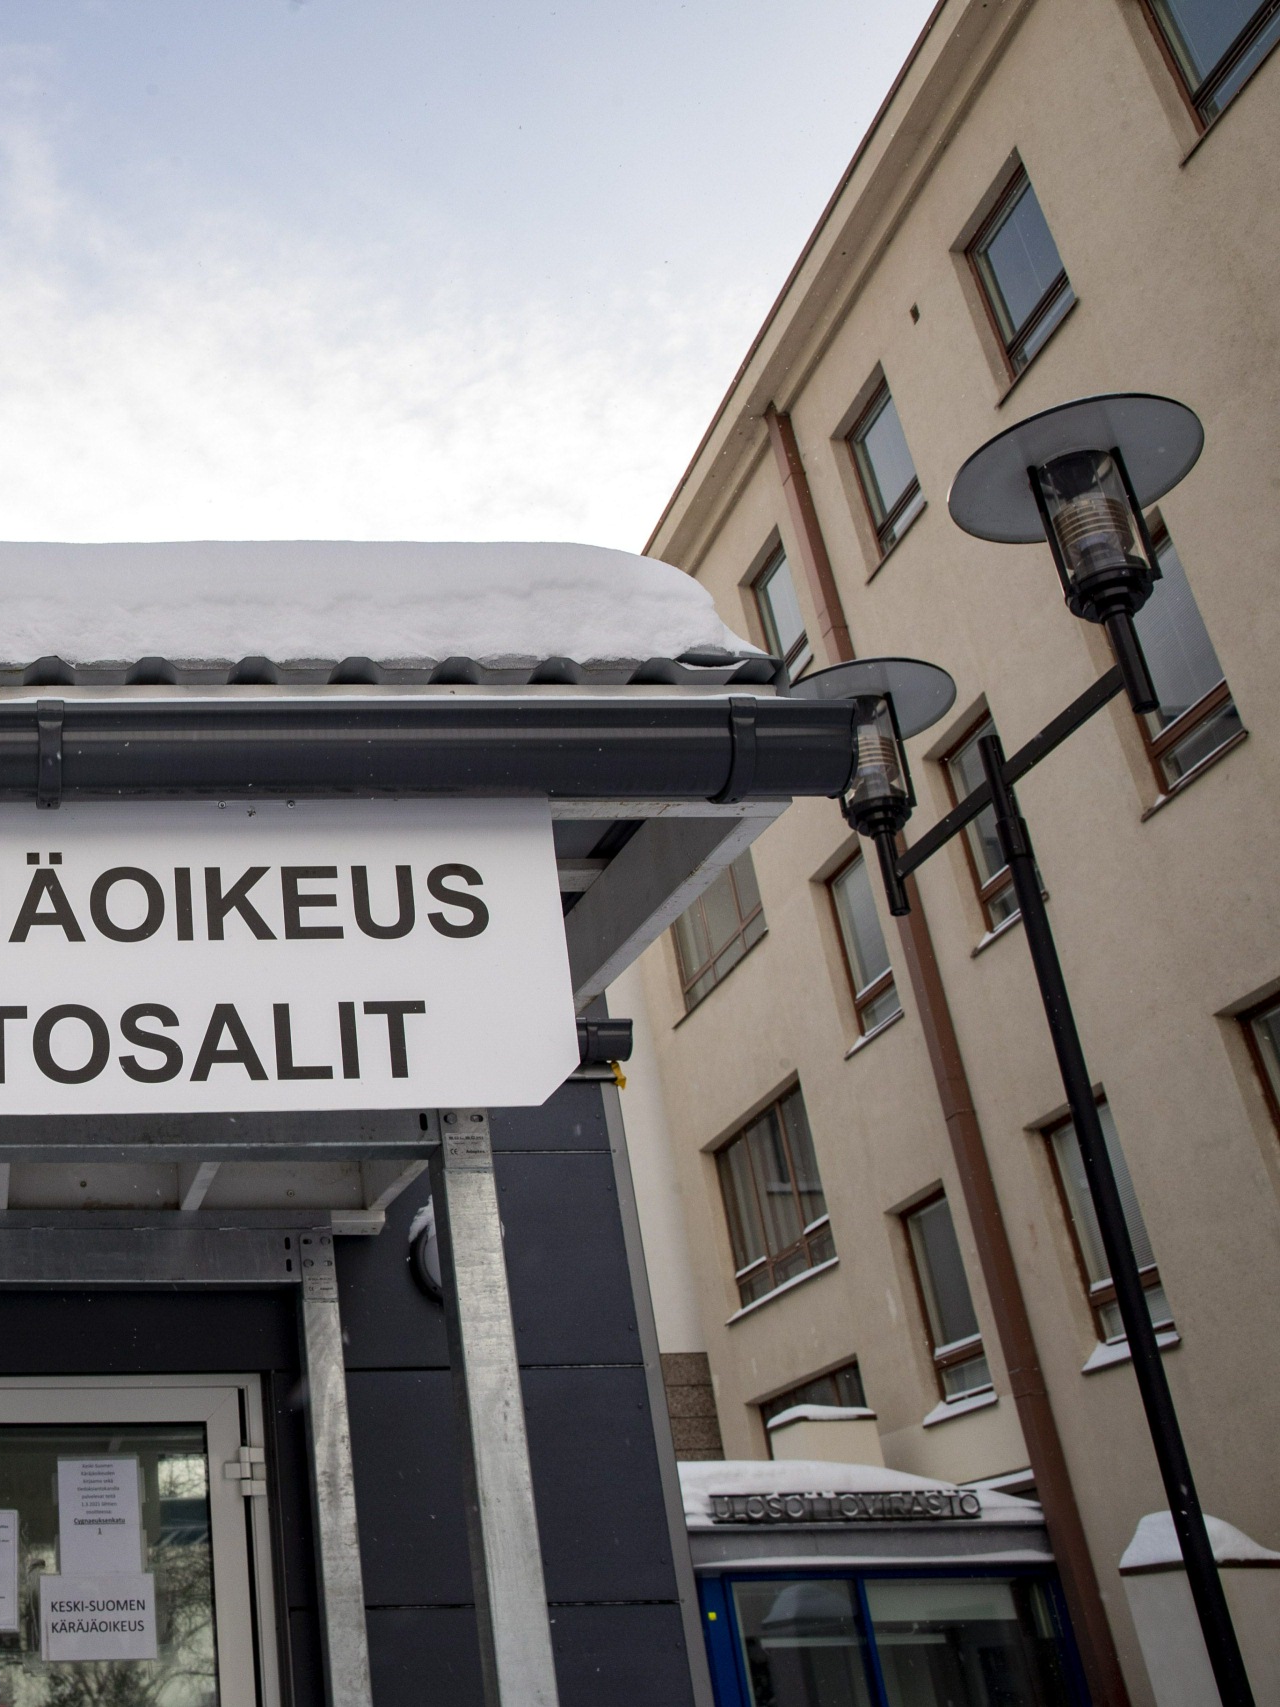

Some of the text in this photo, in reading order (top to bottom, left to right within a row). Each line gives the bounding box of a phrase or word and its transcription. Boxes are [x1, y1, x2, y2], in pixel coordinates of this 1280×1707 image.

[73, 1517, 126, 1526] Cygnaeuksenkatu
[97, 1527, 102, 1535] 1
[51, 1599, 146, 1613] KESKI-SUOMEN
[51, 1618, 145, 1634] KÄRÄJÄOIKEUS
